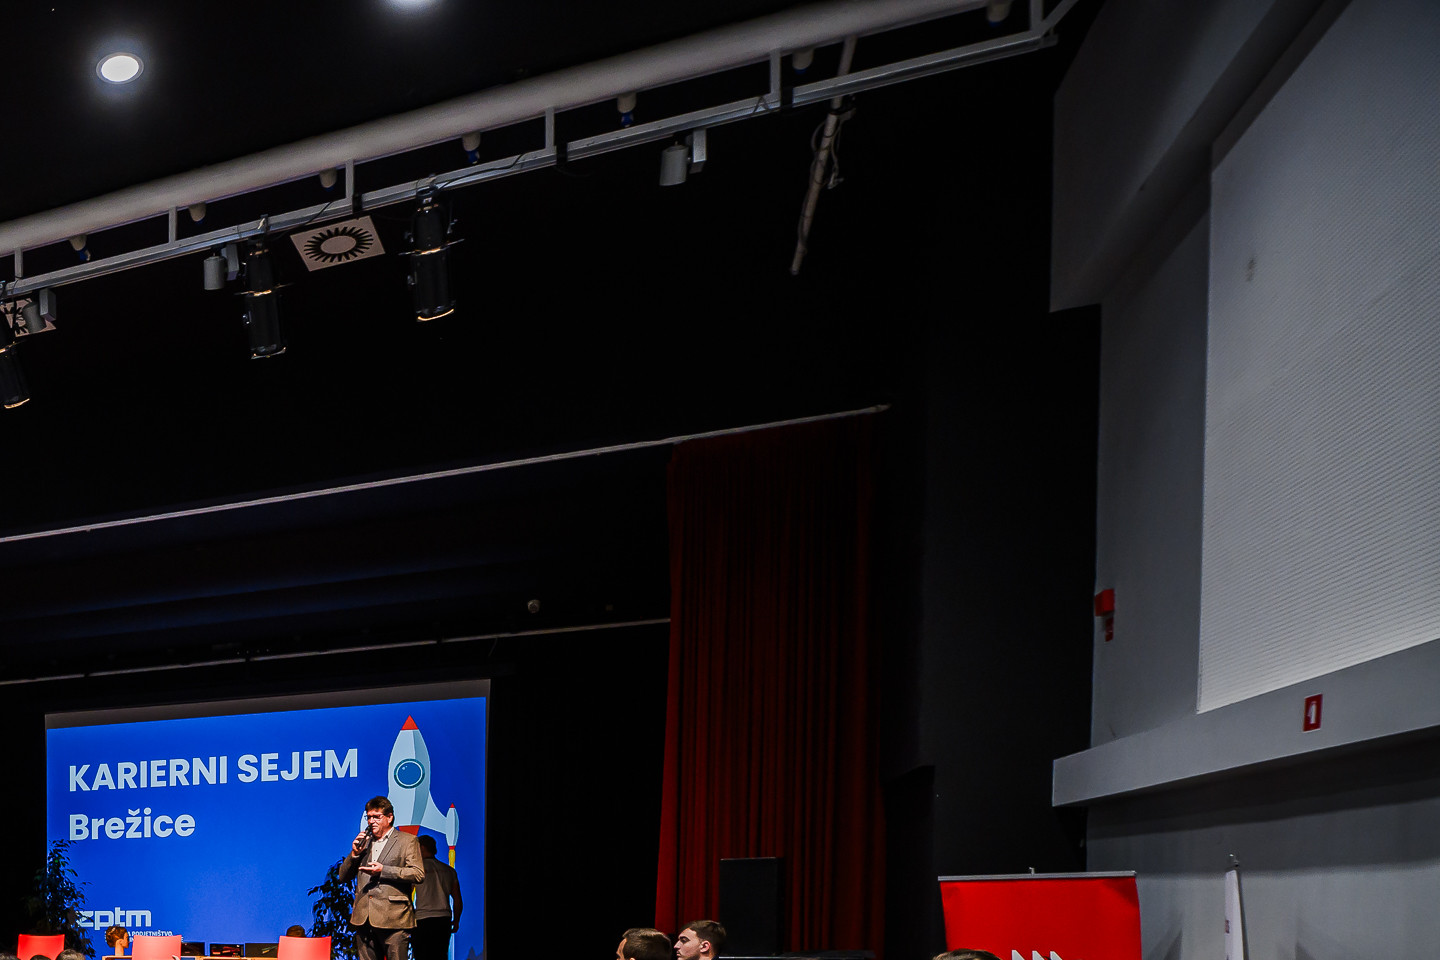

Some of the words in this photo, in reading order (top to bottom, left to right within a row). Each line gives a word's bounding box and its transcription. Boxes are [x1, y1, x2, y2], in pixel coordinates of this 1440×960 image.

[69, 756, 228, 792] KARIERNI
[237, 748, 358, 783] SEJEM
[69, 807, 196, 841] Brežice
